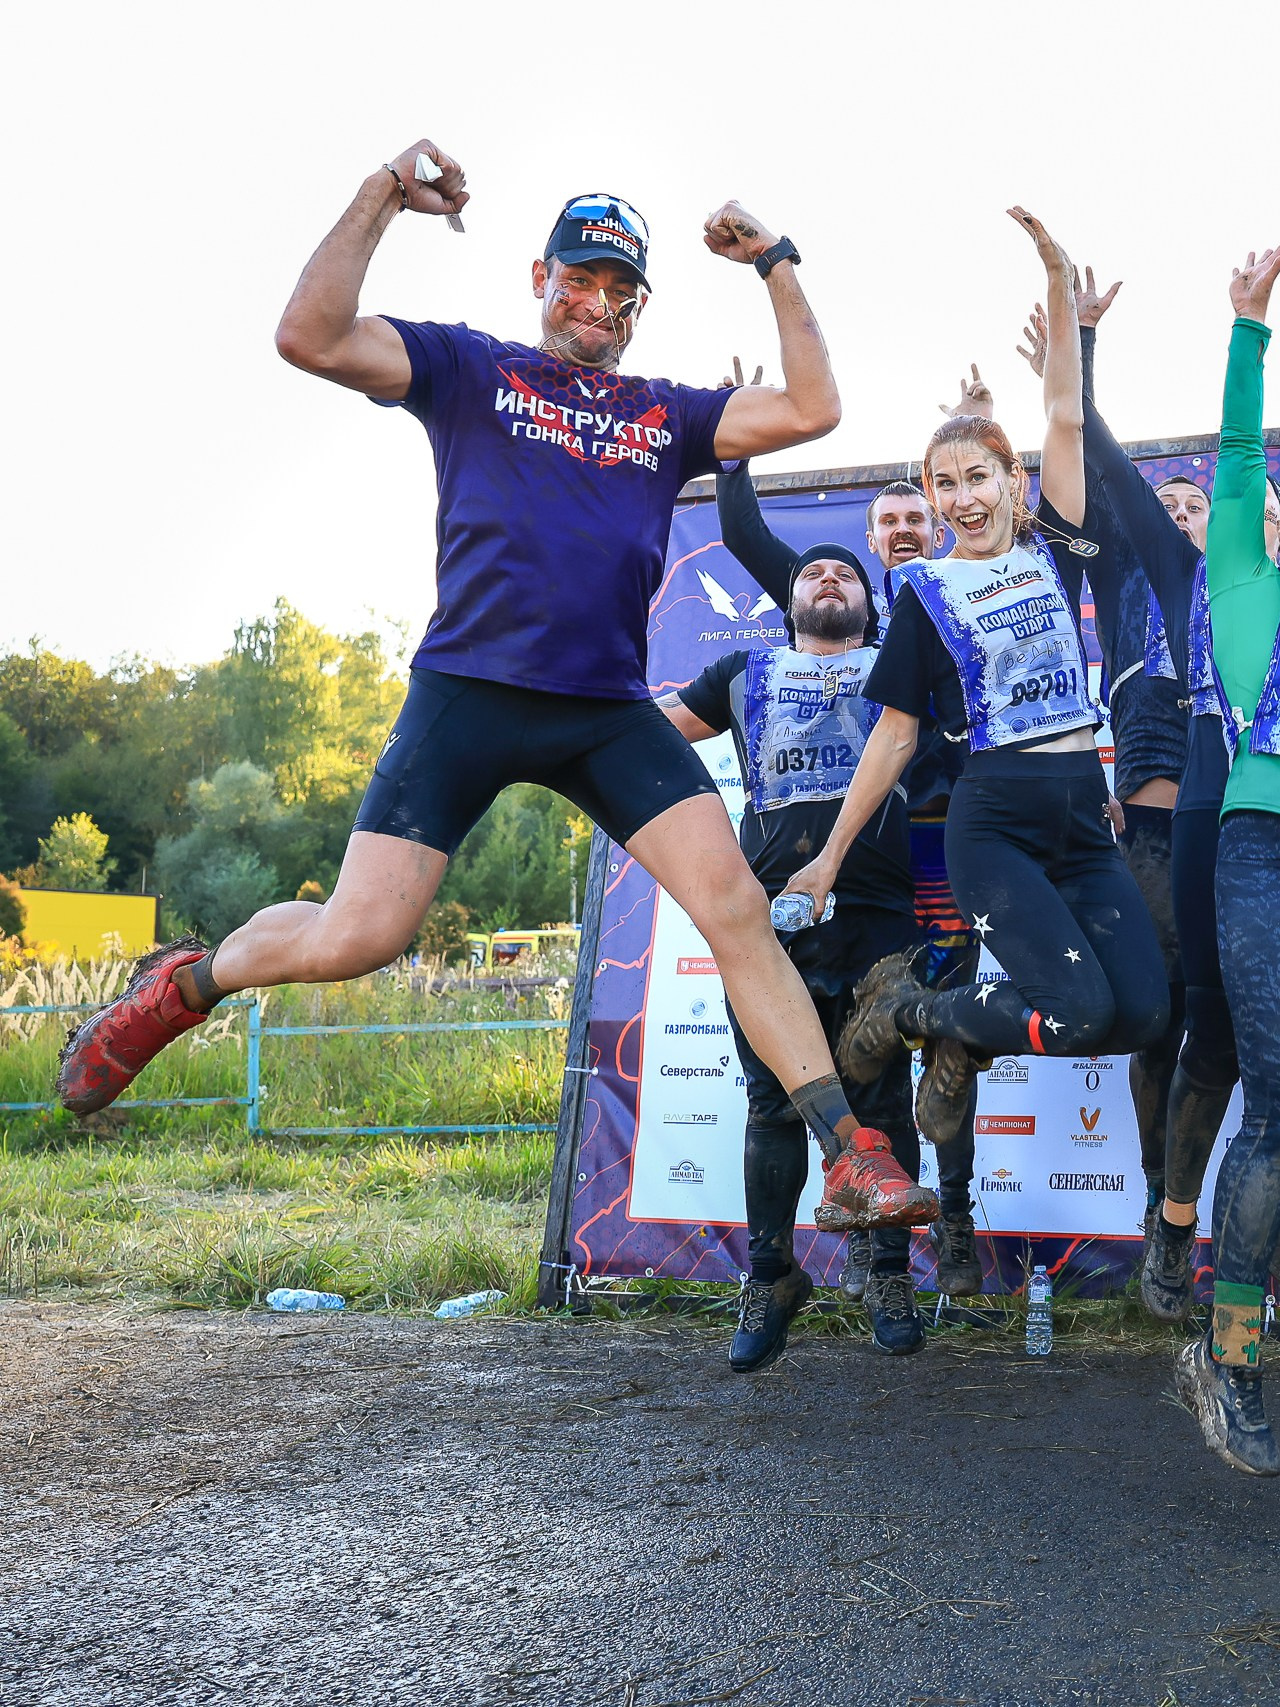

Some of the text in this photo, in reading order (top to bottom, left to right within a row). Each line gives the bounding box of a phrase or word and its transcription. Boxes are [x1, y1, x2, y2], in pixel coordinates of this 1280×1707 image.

[581, 229, 639, 260] ГЕРОЕВ
[494, 387, 673, 451] ИНСТРУКТОР
[512, 421, 659, 472] ГОНКА ГЕРОЕВ
[965, 580, 1005, 601] ГОНКА
[979, 593, 1065, 633] КОМАНДНЫЙ
[698, 627, 785, 642] ЛИГА ГЕРОЕВ
[1014, 613, 1053, 639] СТАРТ
[785, 670, 821, 679] ГОНКА
[779, 680, 861, 704] КОМАНЫЙ
[1010, 668, 1077, 706] 03701
[1031, 709, 1088, 727] ГАЗПРОМБАНК
[775, 743, 854, 776] 03702
[794, 779, 850, 794] ГАЗПРОМБАН
[664, 1024, 729, 1035] ГАЗПРОМБАНК
[660, 1064, 725, 1080] Северсталь
[989, 1121, 1031, 1129] ЧЕМПИОНАТ
[671, 1171, 703, 1180] AHMAD TEA
[1048, 1172, 1125, 1192] СЕНЕЖСКАЯ
